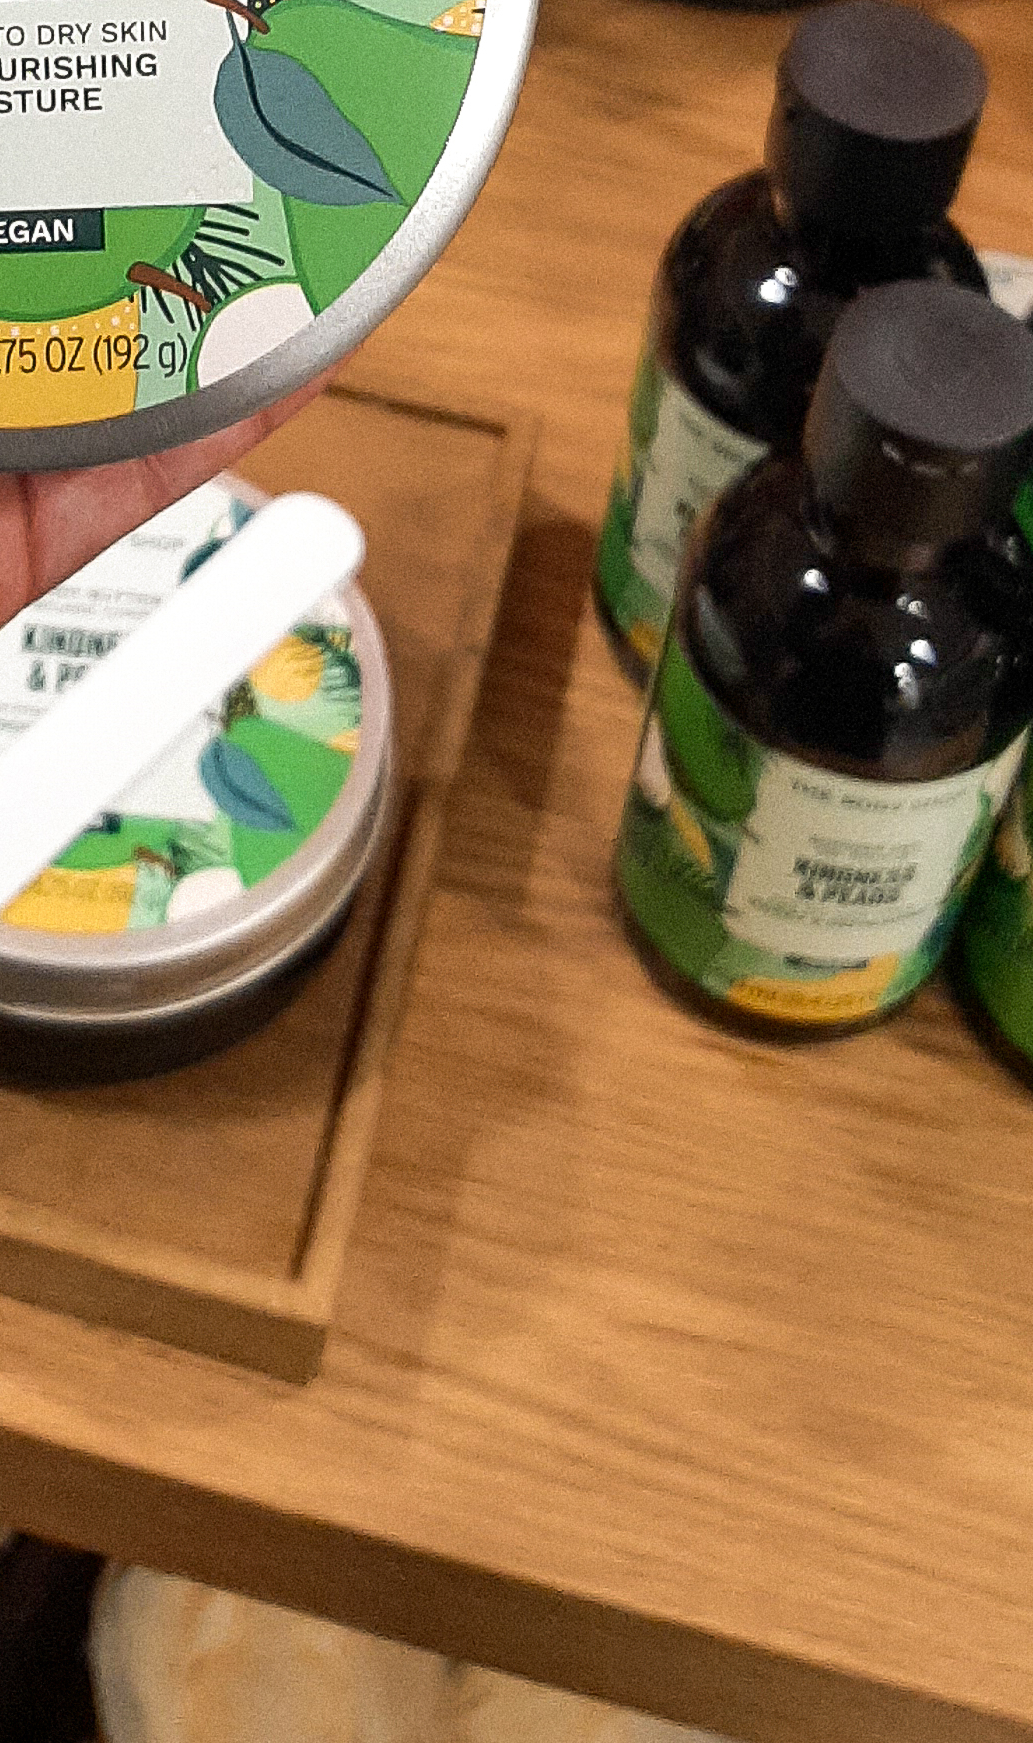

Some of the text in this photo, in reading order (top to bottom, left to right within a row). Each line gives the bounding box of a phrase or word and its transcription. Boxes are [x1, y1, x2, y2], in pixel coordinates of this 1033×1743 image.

[37, 22, 93, 46] DRY
[101, 19, 168, 43] SKIN
[45, 336, 87, 374] OZ
[93, 333, 151, 376] (192
[157, 331, 189, 379] g)
